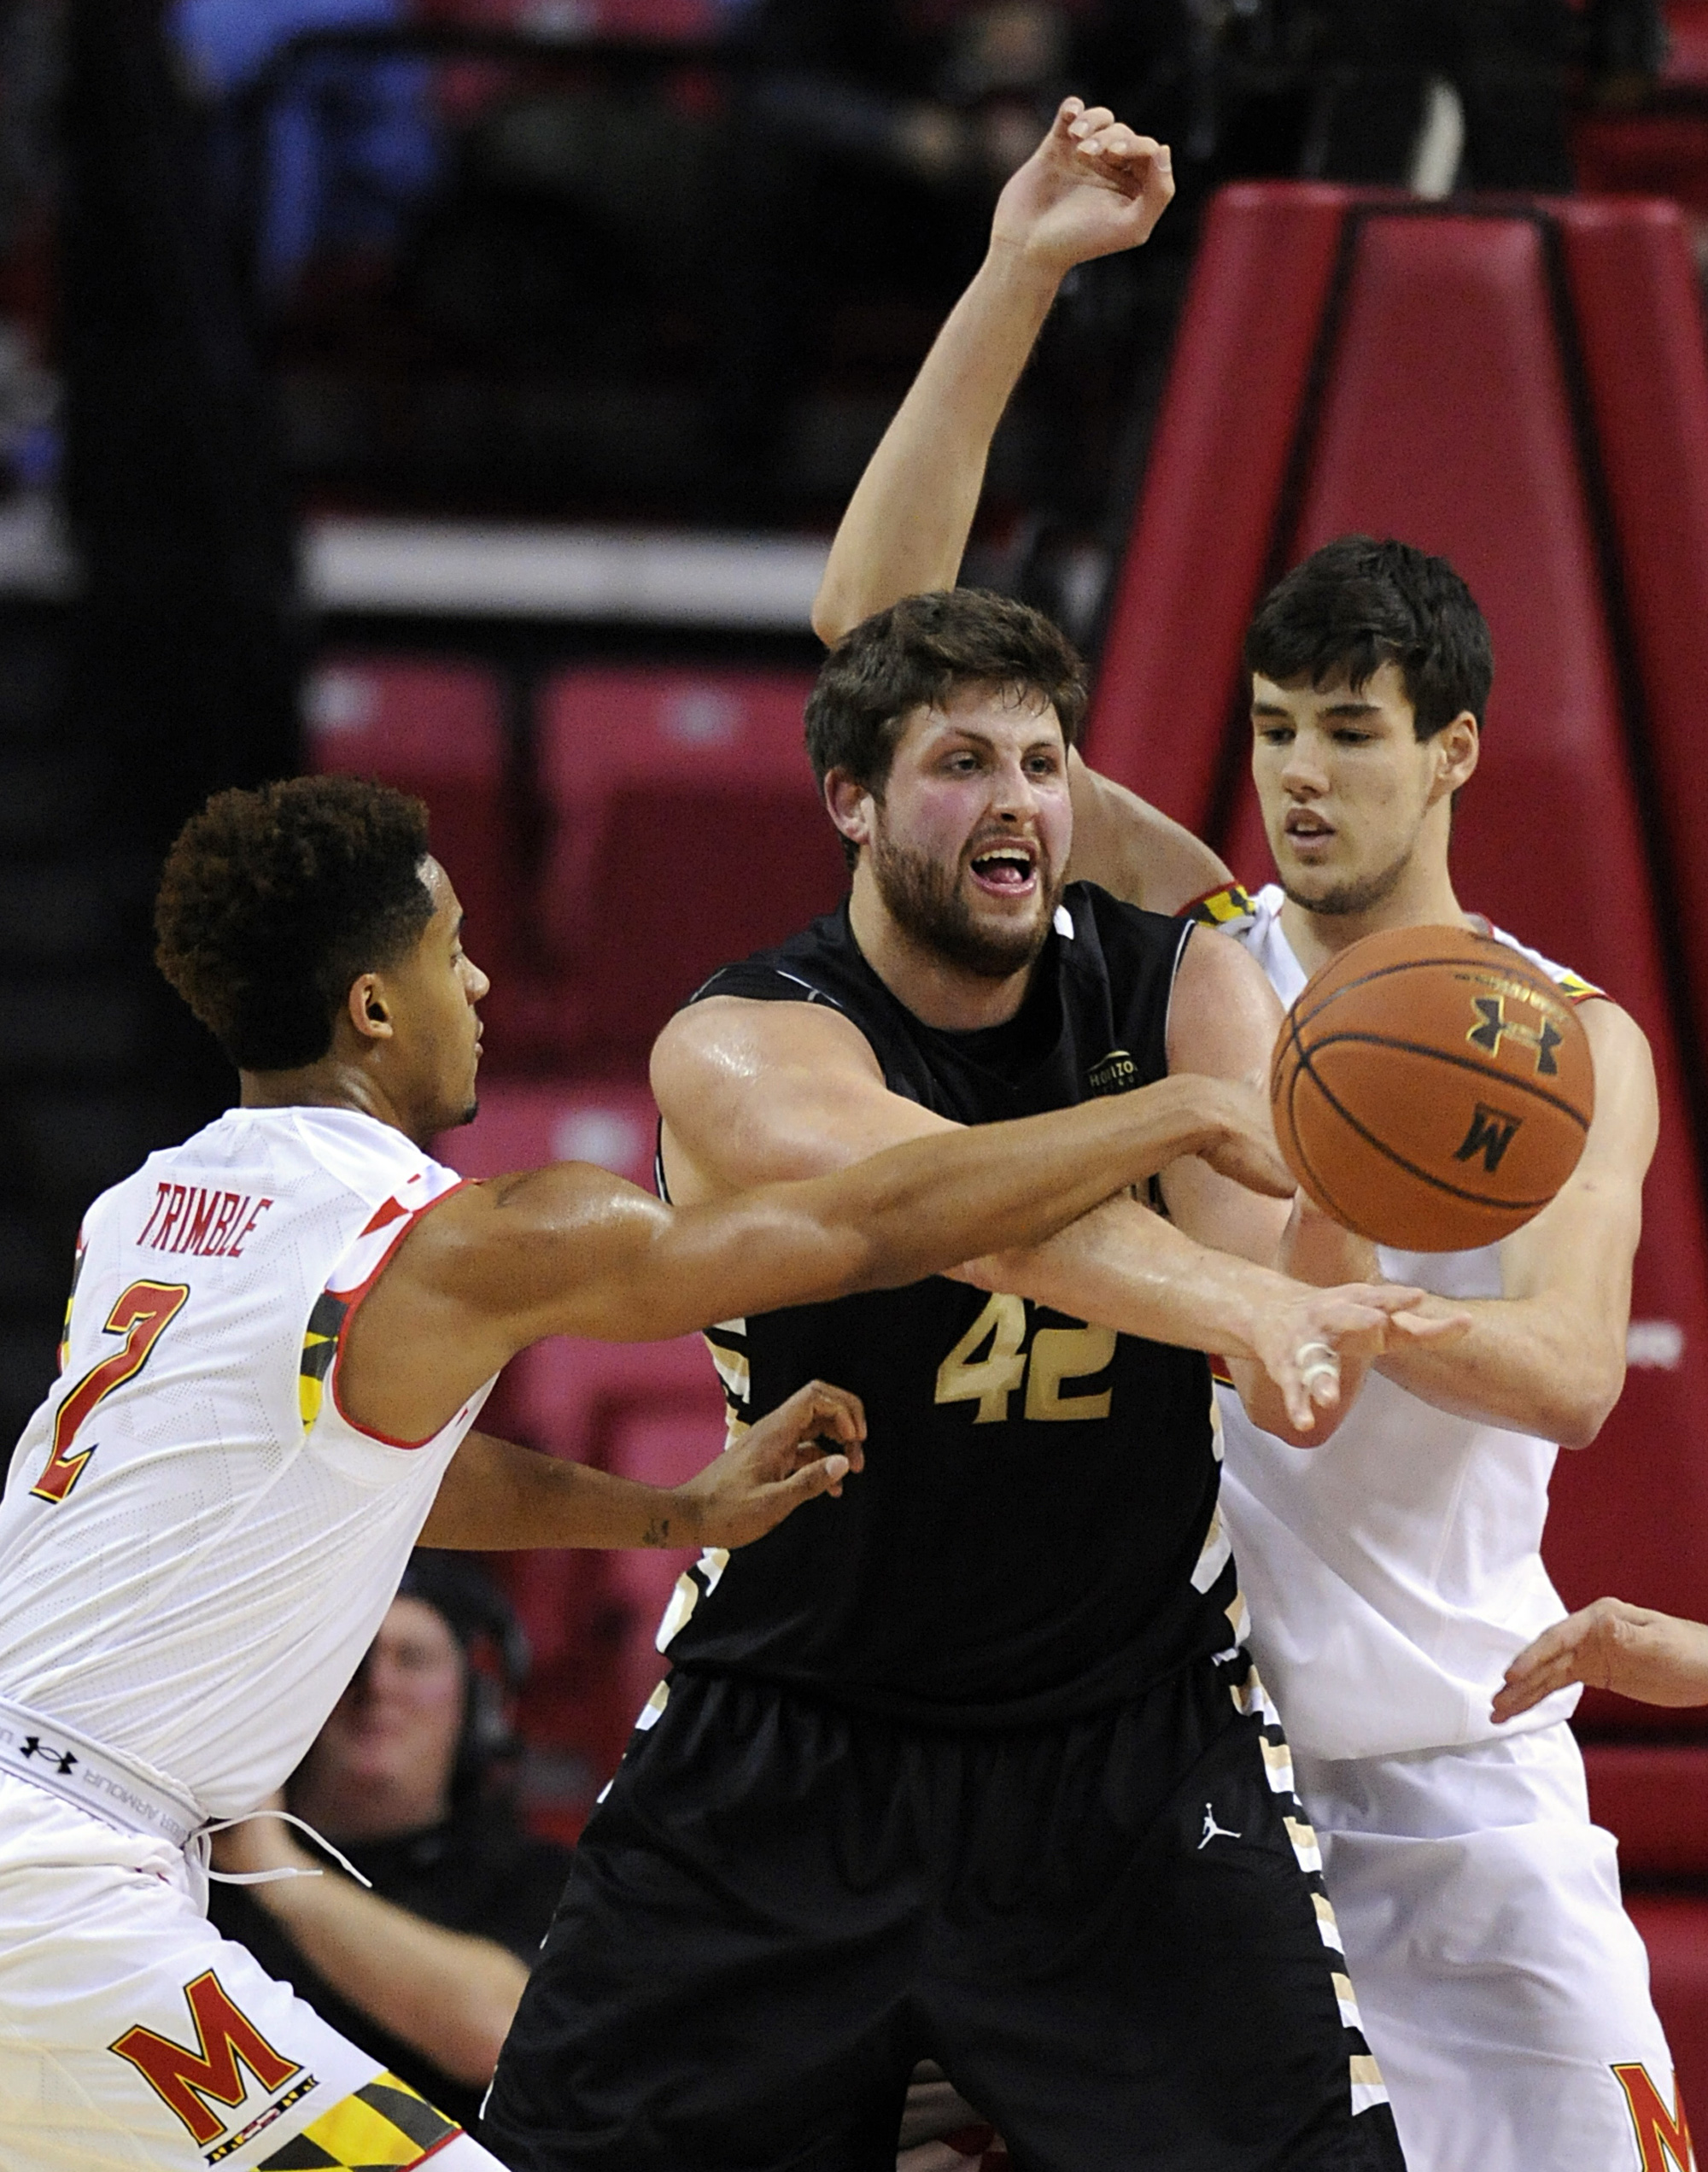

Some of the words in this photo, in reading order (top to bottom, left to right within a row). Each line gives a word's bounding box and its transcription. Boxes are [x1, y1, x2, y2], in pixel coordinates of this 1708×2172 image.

[1089, 1060, 1138, 1086] HORIZO
[136, 1182, 273, 1258] TRIMBLE
[29, 1279, 190, 1505] 2
[934, 1292, 1118, 1425] 42
[83, 1769, 160, 1820] ARMOUR
[108, 1969, 305, 2147] M
